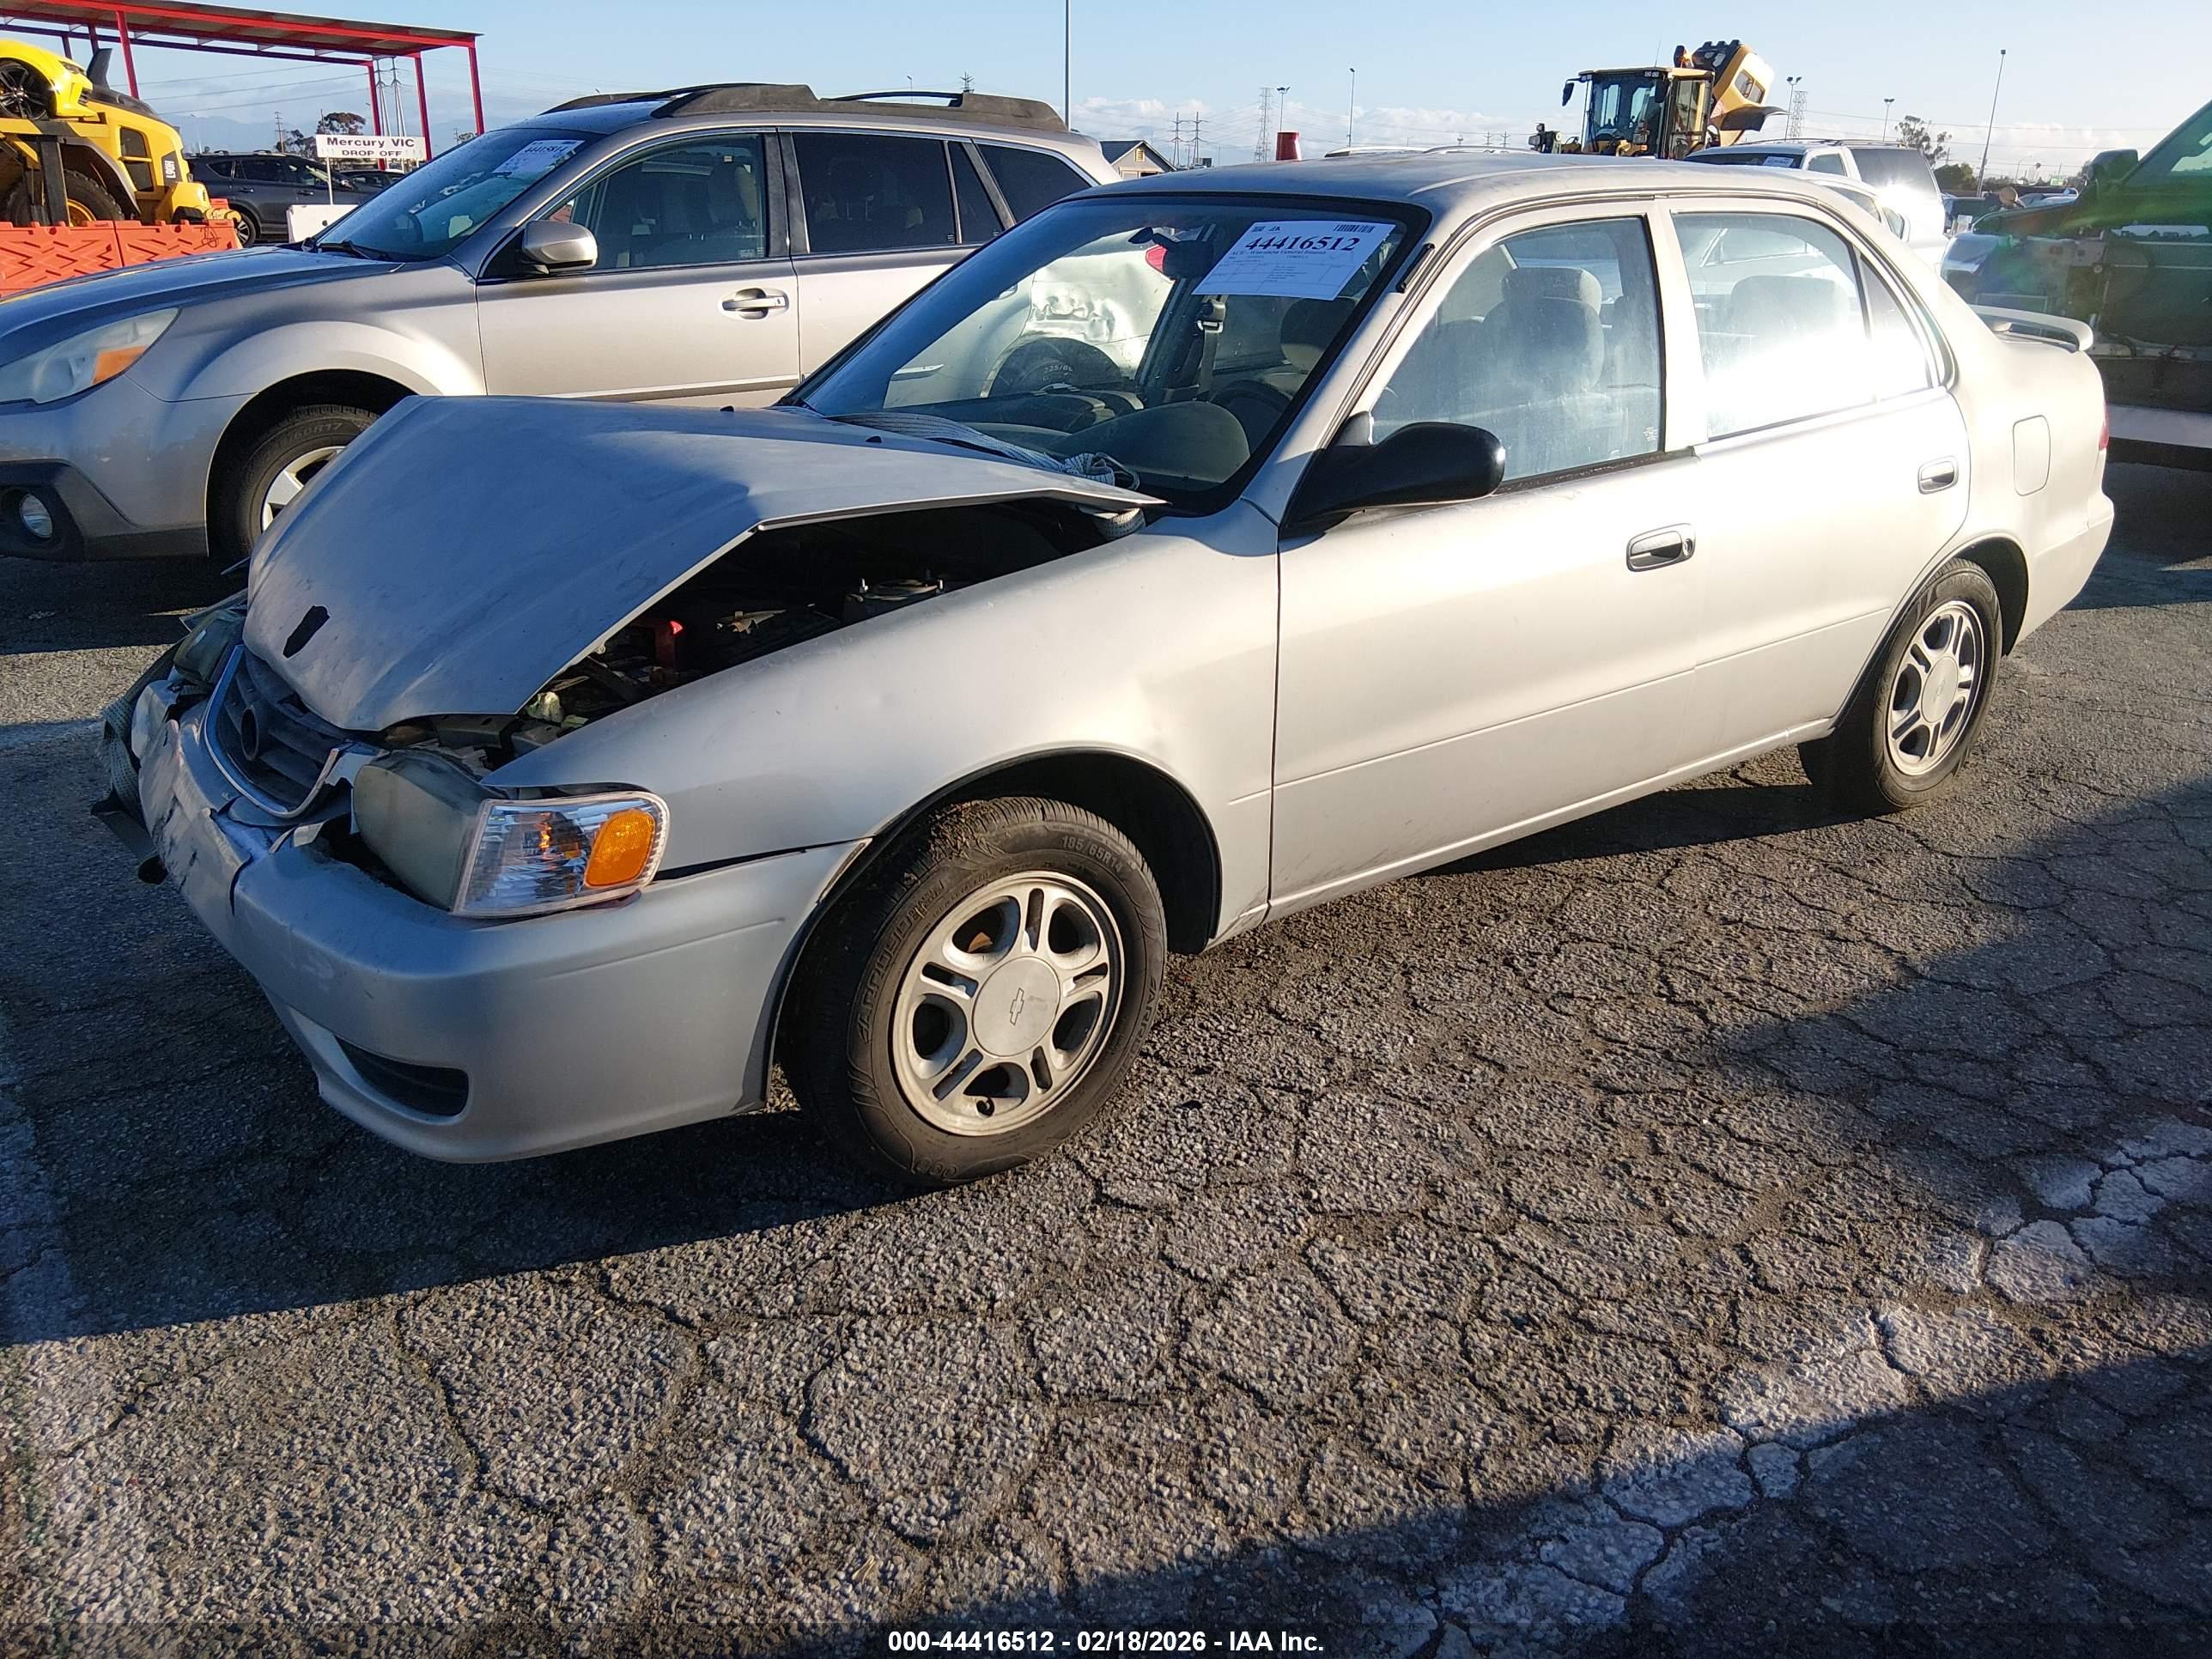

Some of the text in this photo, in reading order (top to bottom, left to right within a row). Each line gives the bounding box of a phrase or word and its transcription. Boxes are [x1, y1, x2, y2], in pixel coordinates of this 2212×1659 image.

[326, 137, 415, 148] Mercury VIC
[1245, 235, 1361, 252] 44416512
[1061, 835, 1123, 873] 185/65R14
